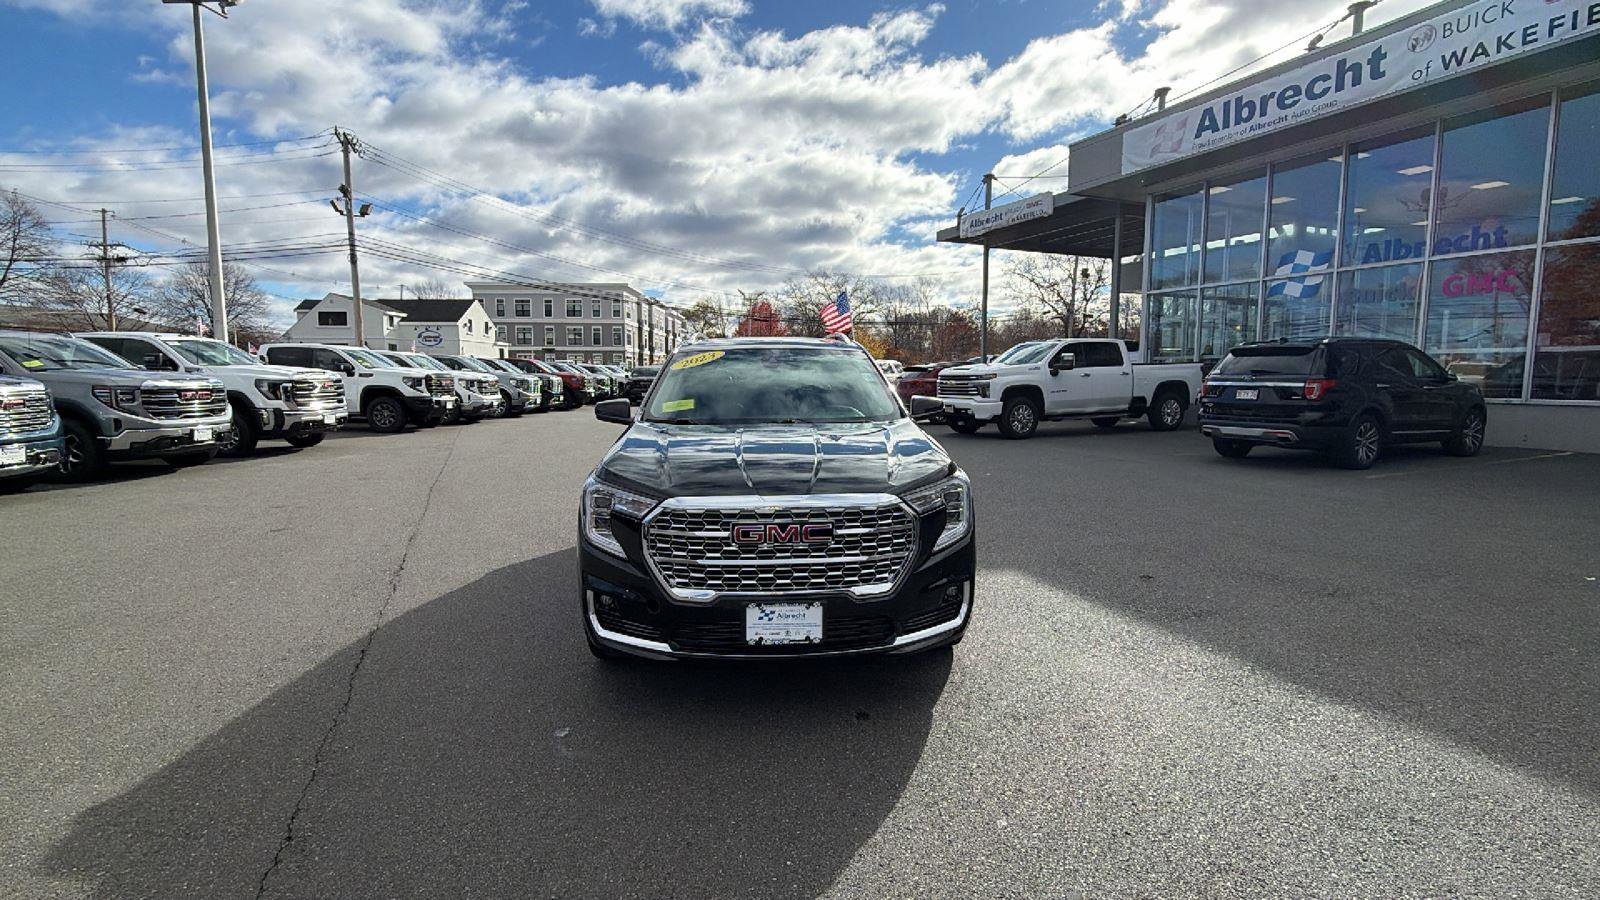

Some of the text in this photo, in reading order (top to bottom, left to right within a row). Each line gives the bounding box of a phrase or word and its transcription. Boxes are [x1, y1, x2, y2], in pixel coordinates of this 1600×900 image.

[1442, 0, 1514, 39] BUICK
[1411, 60, 1433, 81] of
[1194, 44, 1388, 140] Albrecht
[1248, 115, 1289, 134] Albrecht
[969, 212, 1004, 229] Albrecht
[1361, 225, 1509, 264] Albrecht
[1442, 267, 1518, 298] GMC
[734, 524, 833, 544] GMC
[776, 612, 806, 620] Albrecht
